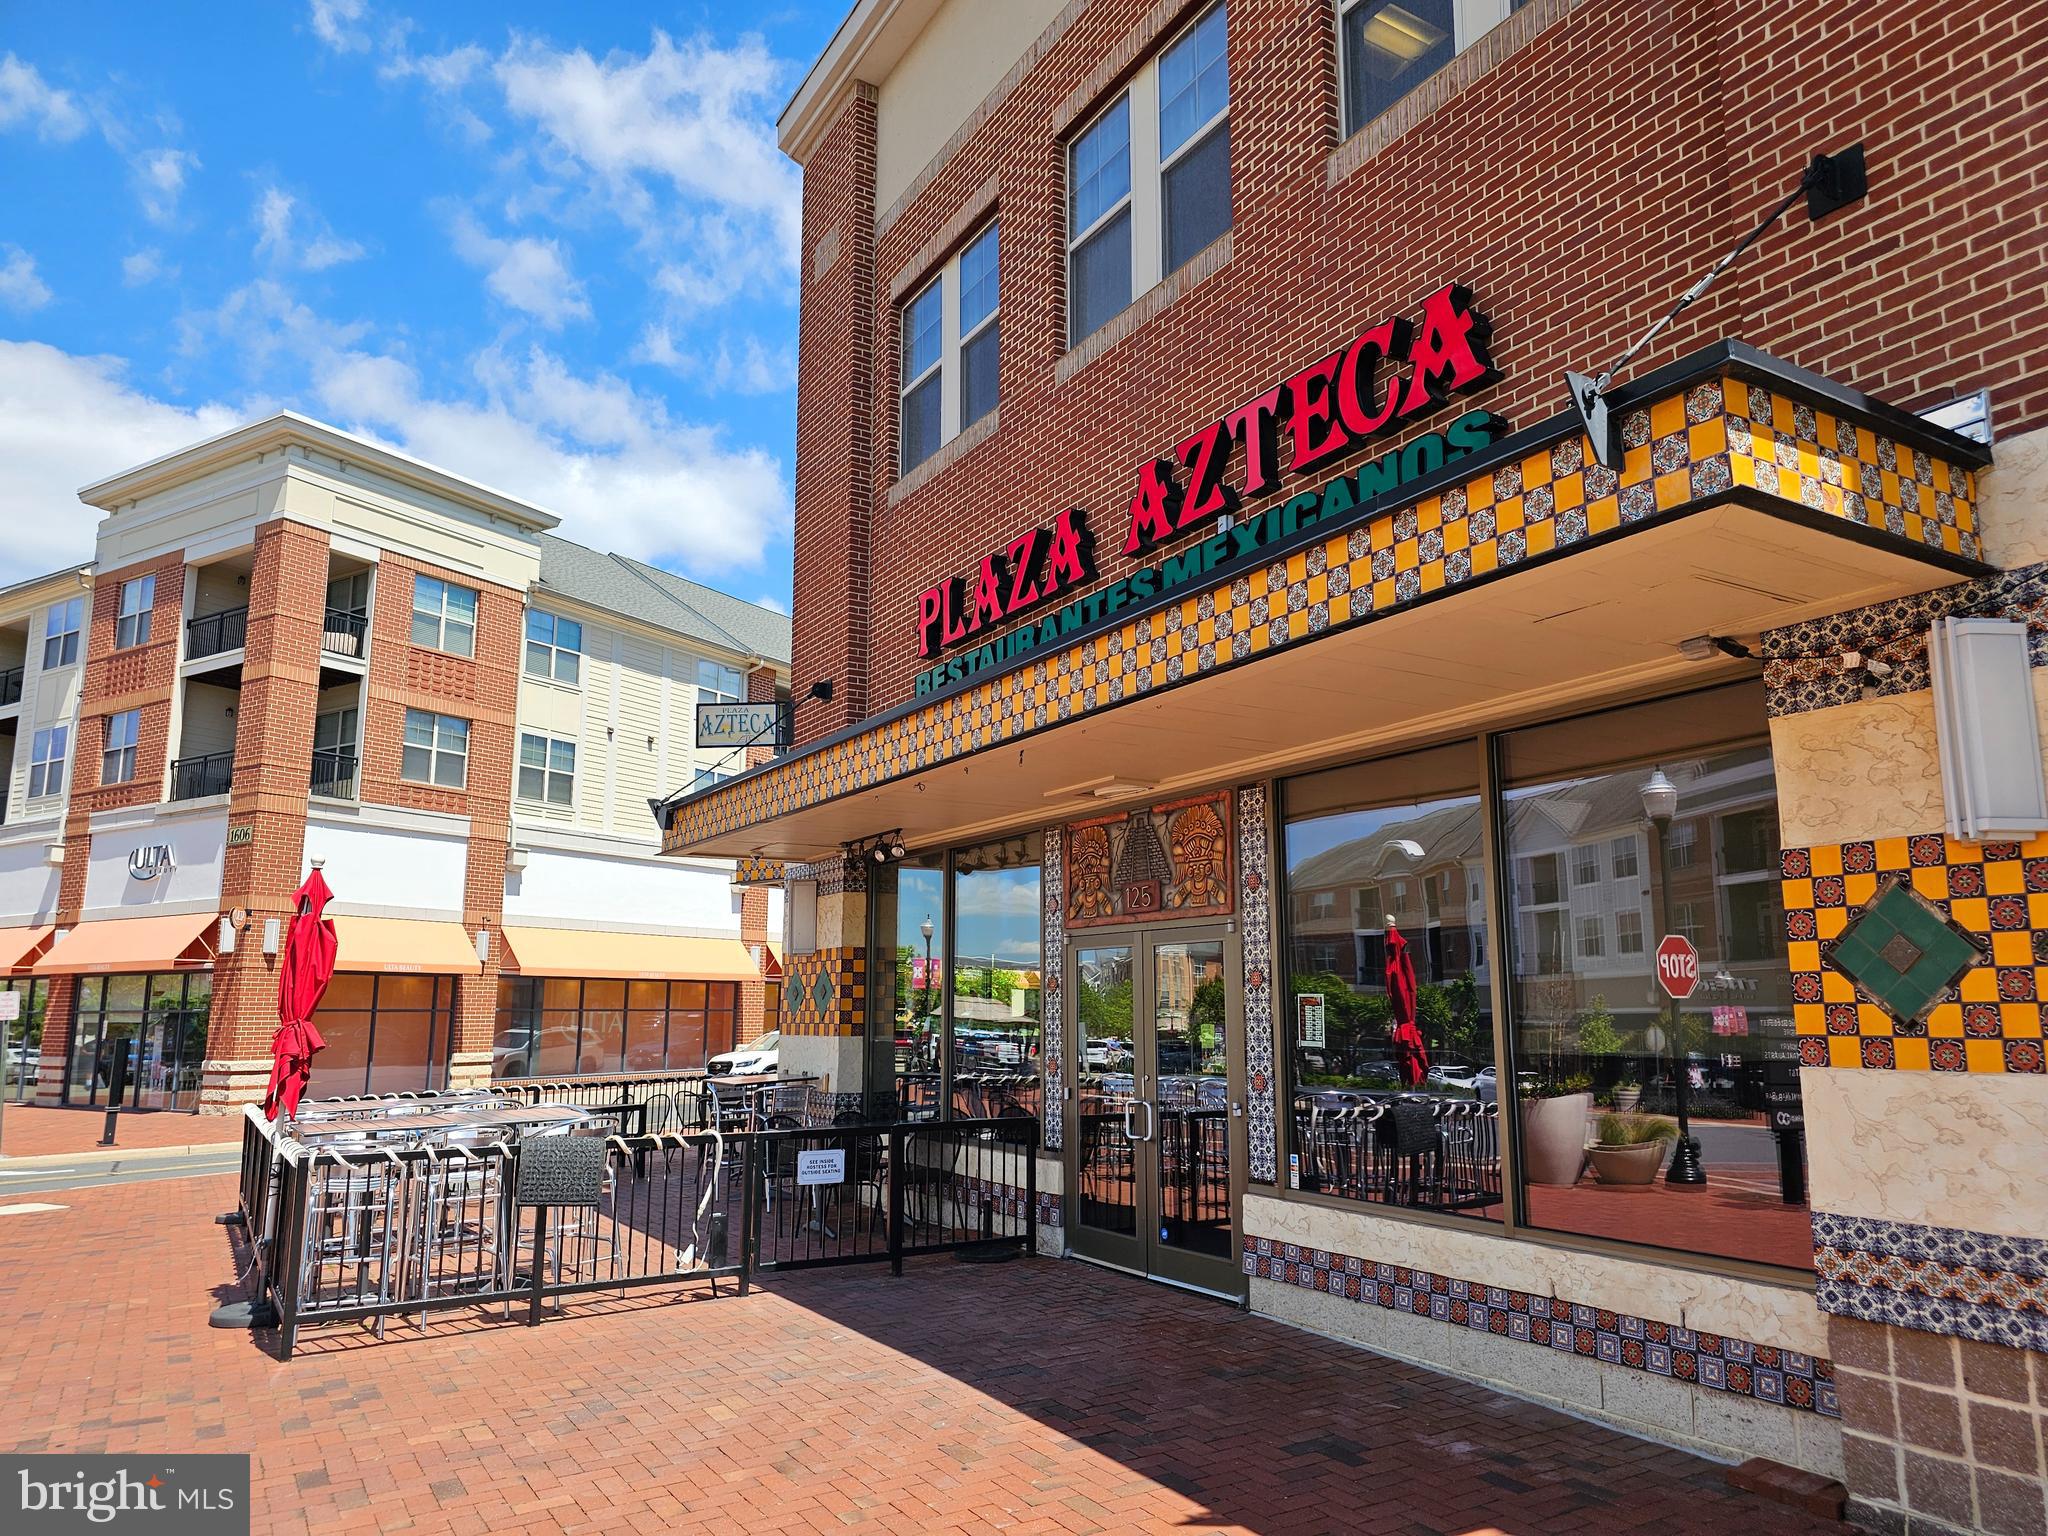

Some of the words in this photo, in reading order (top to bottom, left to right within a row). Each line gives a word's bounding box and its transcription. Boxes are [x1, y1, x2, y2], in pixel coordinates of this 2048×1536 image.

[916, 507, 1090, 659] PLAZA
[1120, 283, 1492, 556] AZTECA
[914, 567, 1155, 700] RESTAURANTES
[699, 712, 775, 738] AZTECA
[229, 827, 251, 843] 1606
[133, 844, 176, 870] ULTA
[1126, 885, 1151, 908] 125
